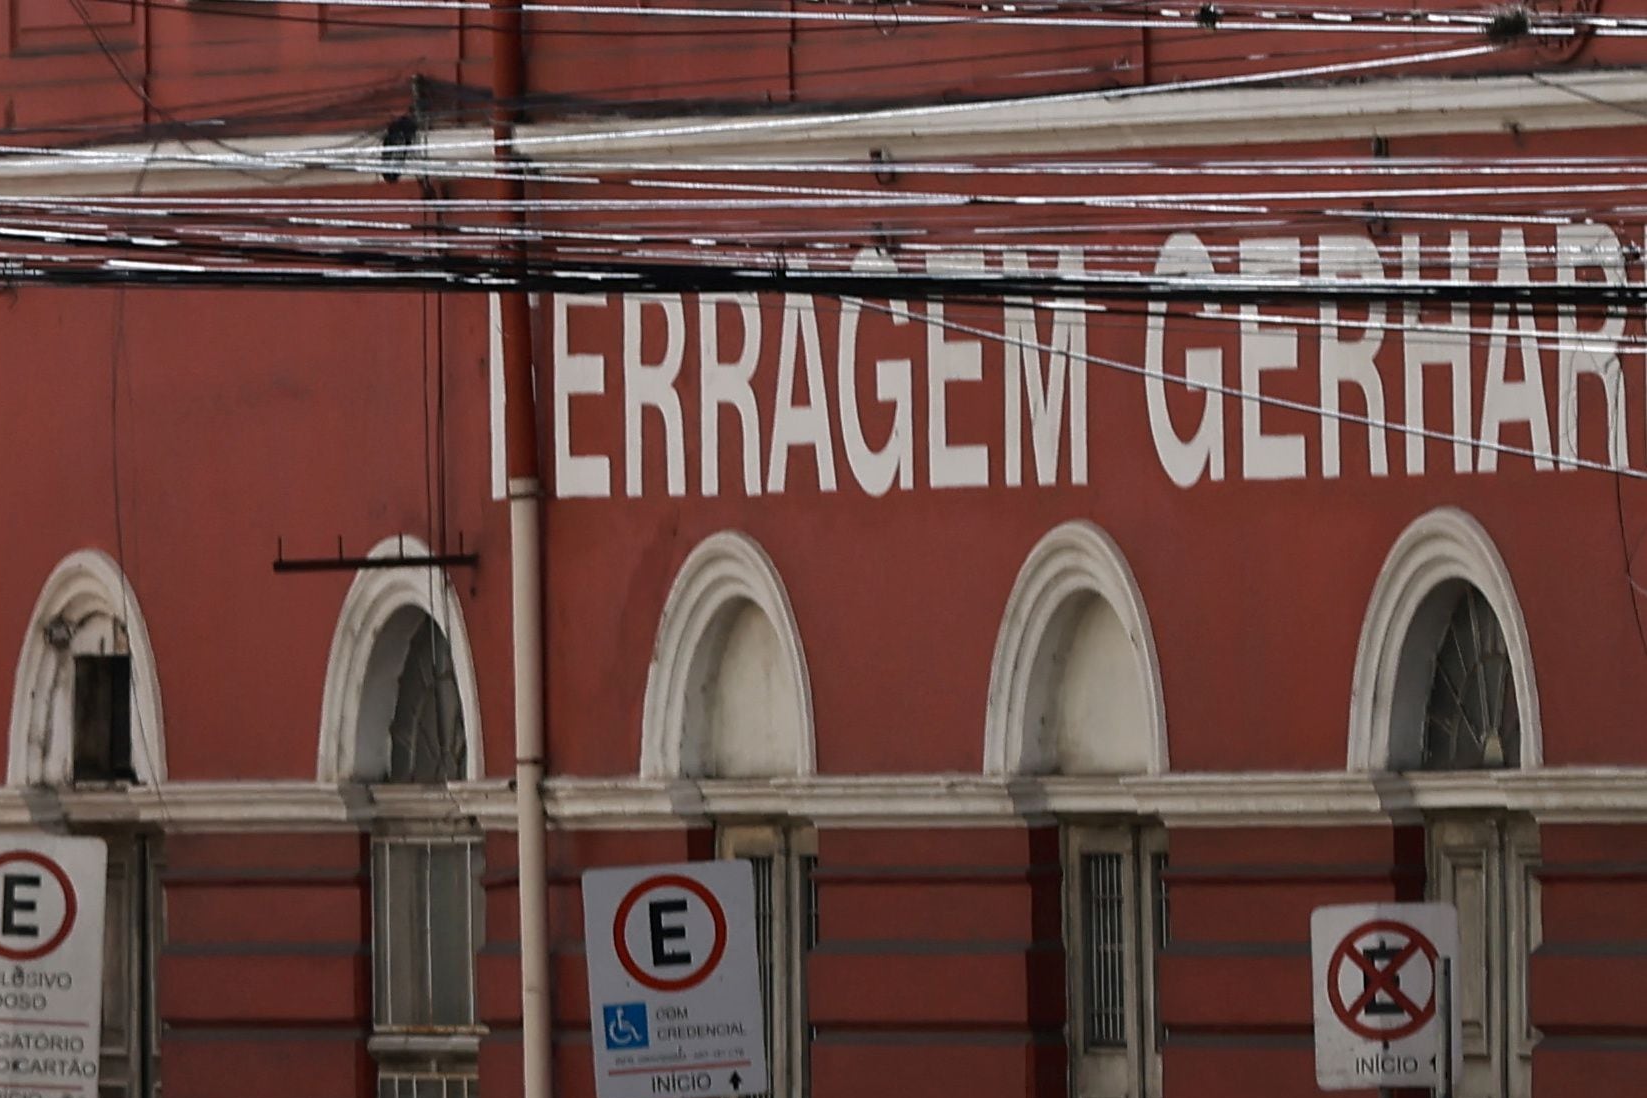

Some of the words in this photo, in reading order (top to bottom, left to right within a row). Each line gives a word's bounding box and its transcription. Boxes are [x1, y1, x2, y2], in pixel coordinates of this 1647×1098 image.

[1144, 222, 1647, 490] GERHAR
[2, 873, 42, 938] E
[649, 897, 692, 967] E
[656, 1006, 688, 1021] COM
[656, 1021, 747, 1042] CREDENCIAL
[12, 1055, 97, 1079] CARTÃO
[1356, 1053, 1418, 1075] INÍCIO
[651, 1070, 712, 1094] INÍCIO
